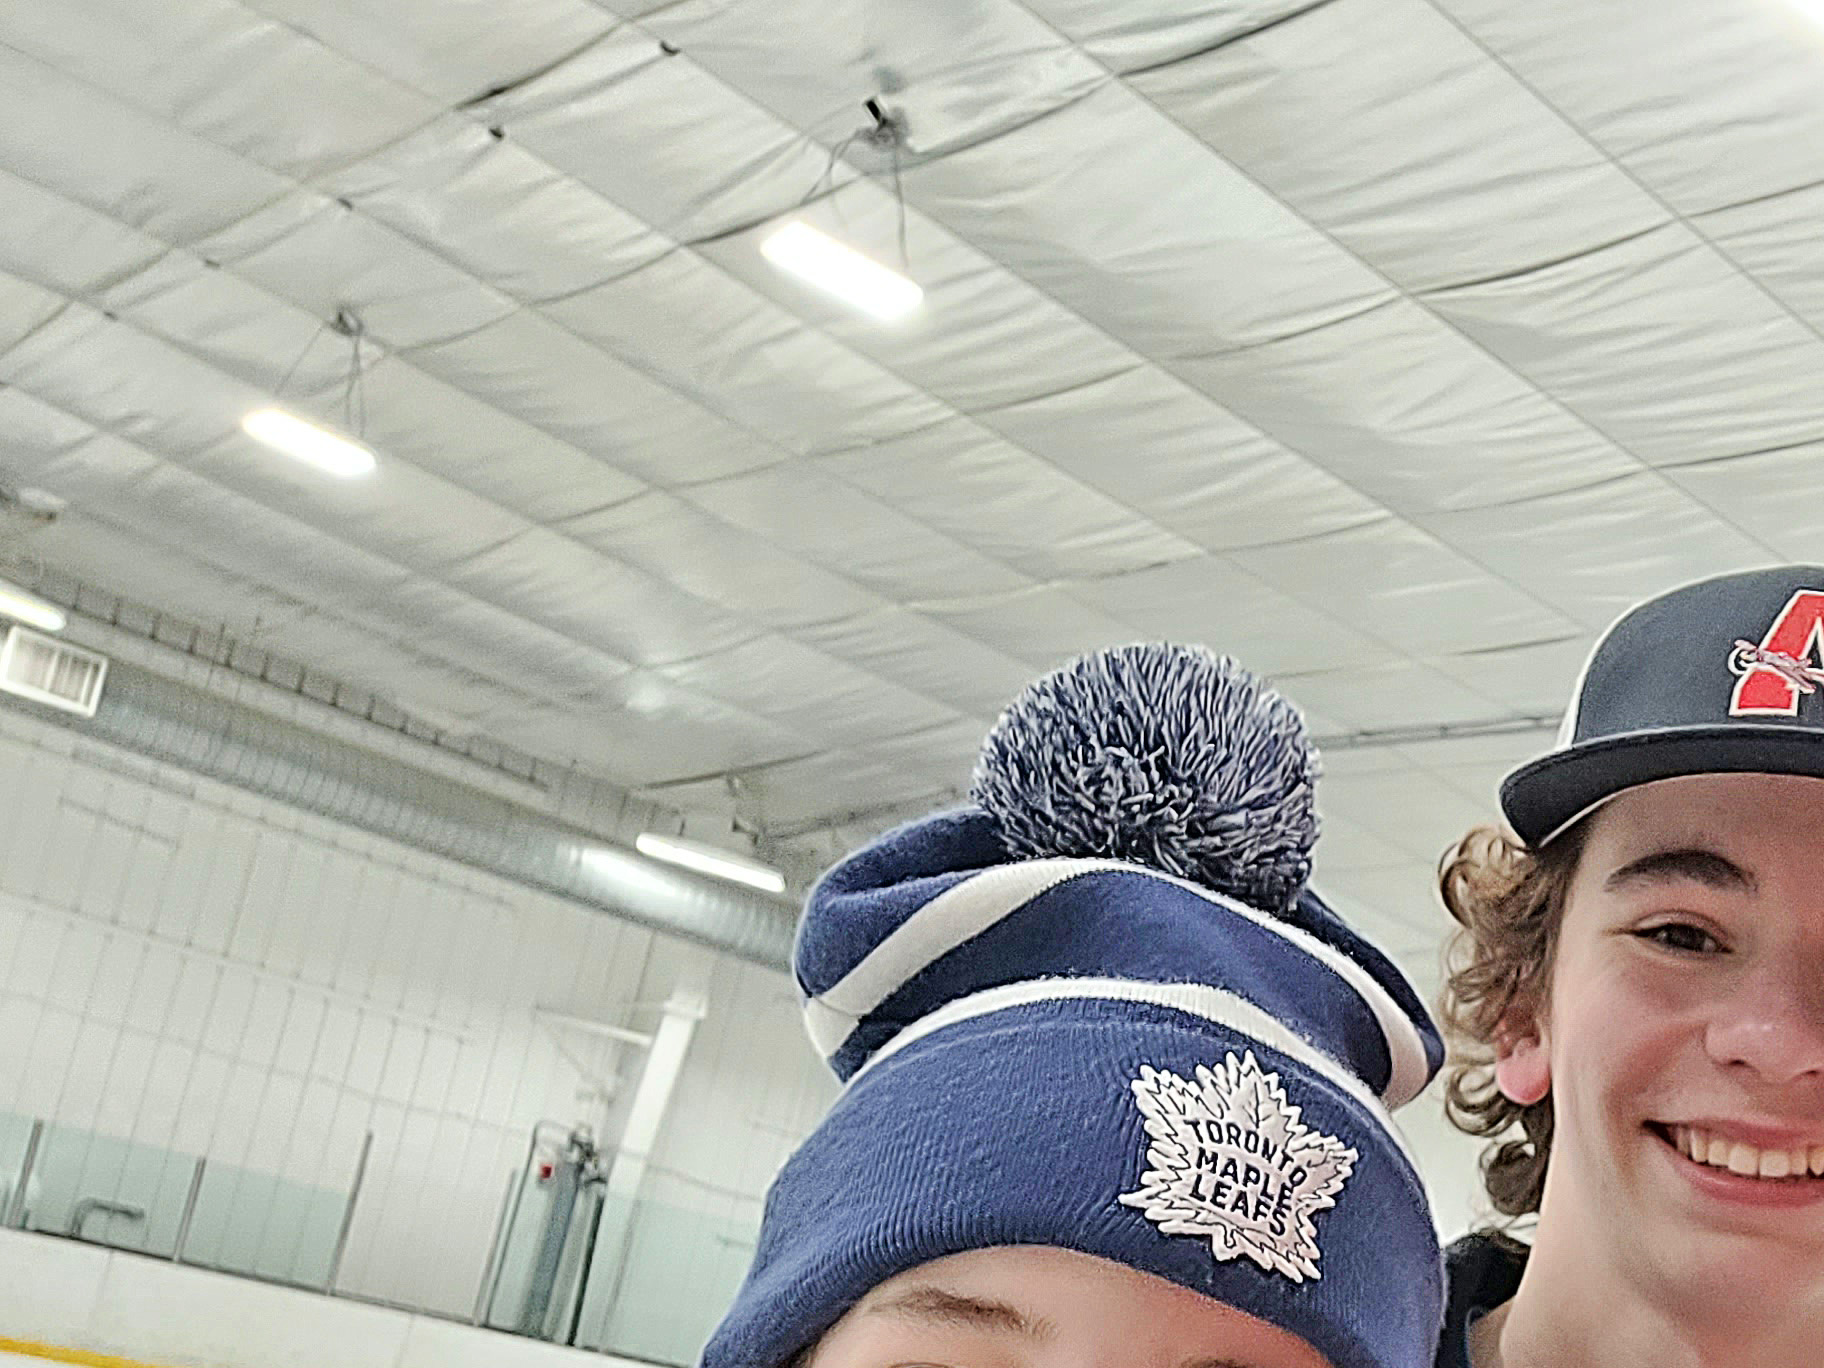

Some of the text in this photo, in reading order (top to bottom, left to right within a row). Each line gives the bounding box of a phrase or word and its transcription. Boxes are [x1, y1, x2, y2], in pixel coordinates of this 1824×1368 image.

[1184, 1119, 1308, 1188] TORONTO
[1196, 1147, 1294, 1212] MAPLE
[1189, 1175, 1287, 1237] LEAFS
